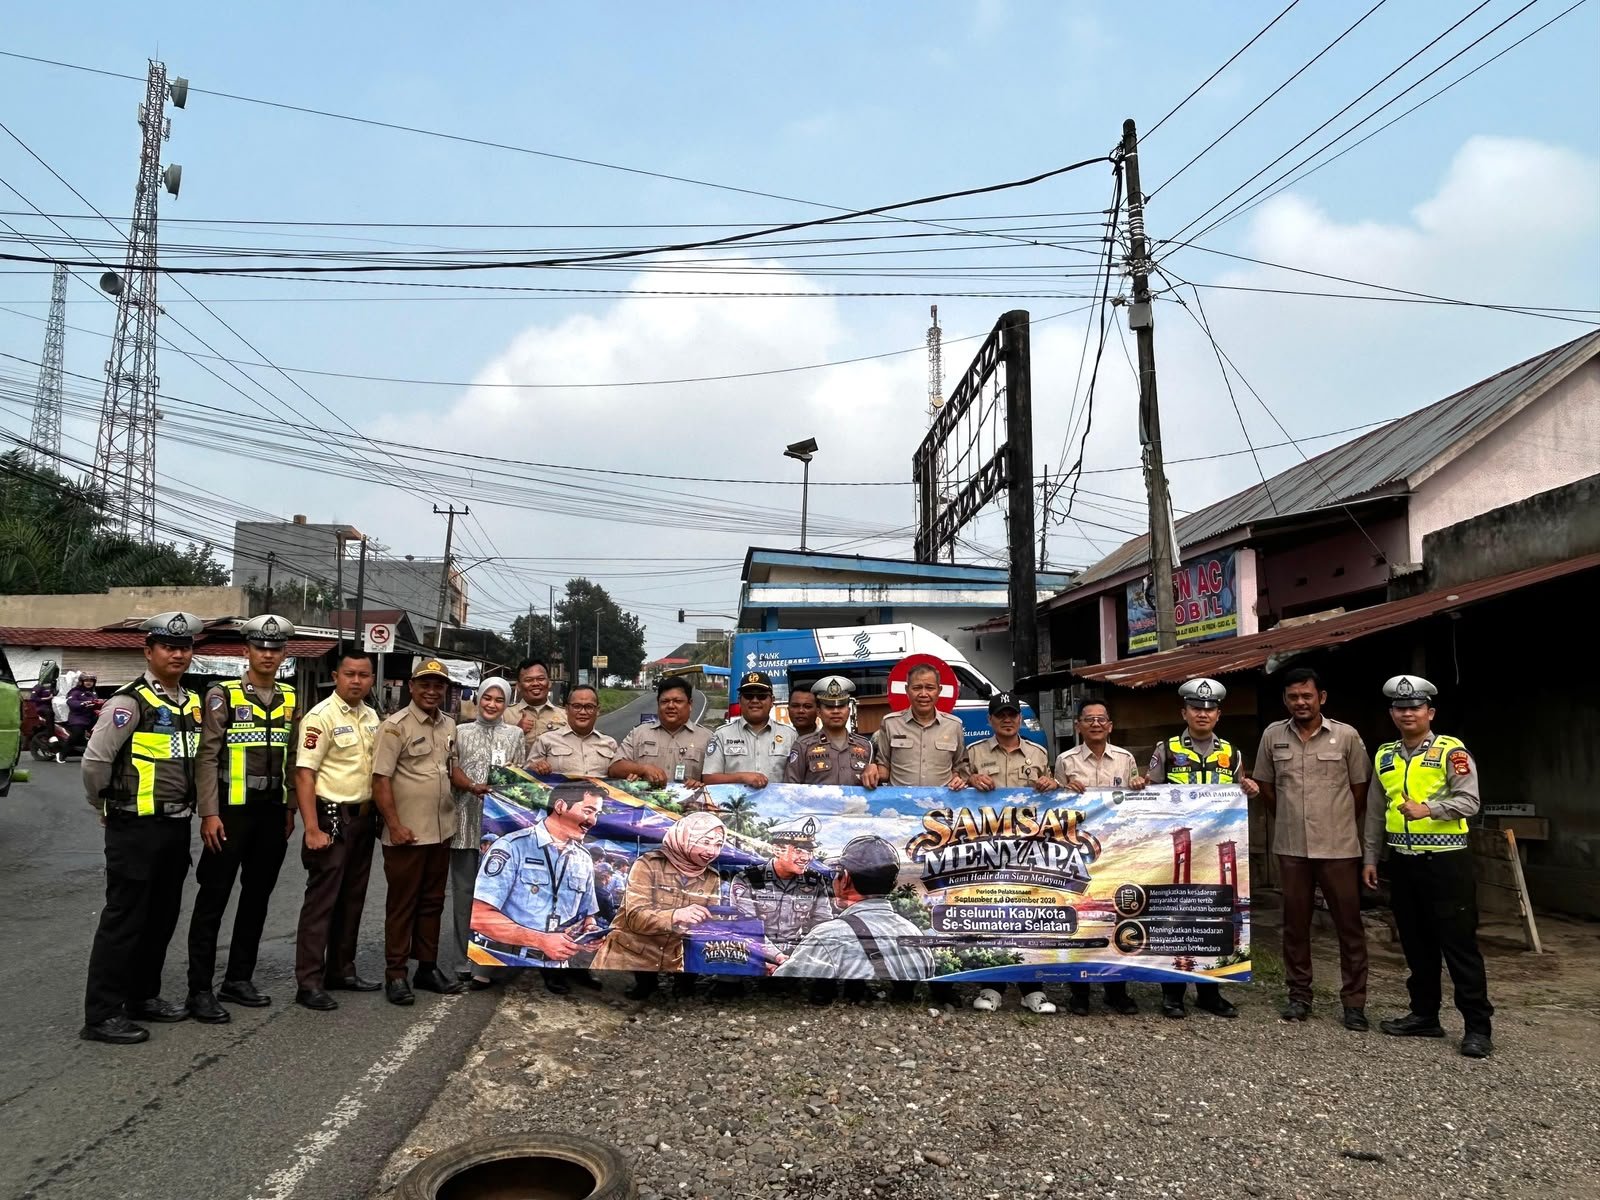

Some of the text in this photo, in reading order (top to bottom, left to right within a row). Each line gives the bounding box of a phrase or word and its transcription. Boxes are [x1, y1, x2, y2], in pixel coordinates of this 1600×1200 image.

[1198, 560, 1224, 598] AC
[1175, 597, 1223, 625] OBIL
[759, 652, 779, 660] BANK
[921, 806, 1088, 851] SAMSAT
[920, 840, 1091, 881] MENYAPA
[948, 872, 1067, 887] Kami Hadir dan Siap Melayani
[954, 895, 993, 904] September
[1149, 889, 1187, 897] Meningkatkan
[946, 907, 1066, 920] di seluruh Kab/Kota
[942, 918, 1071, 932] Se-Sumatera Selatan
[1149, 926, 1192, 935] Meningkatkan
[705, 949, 748, 962] MENYAPA
